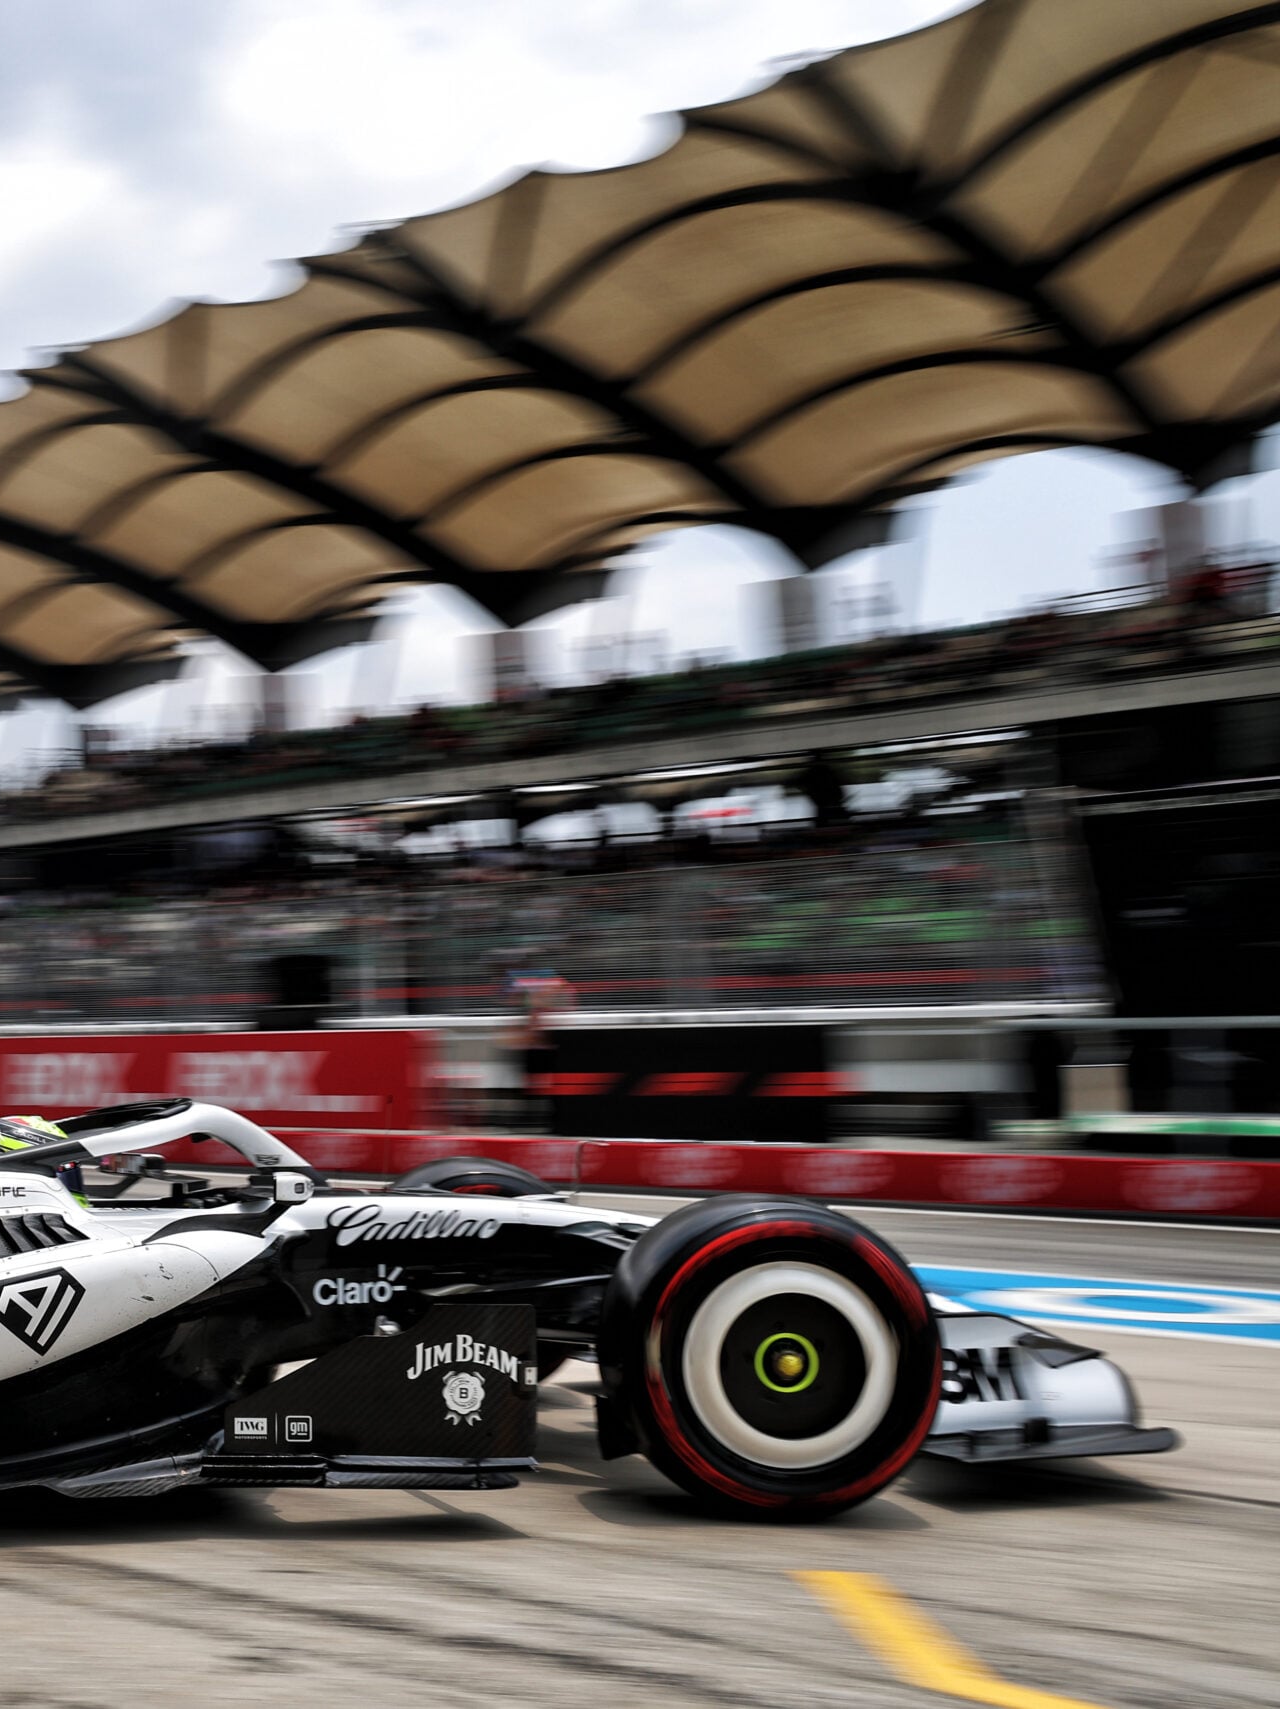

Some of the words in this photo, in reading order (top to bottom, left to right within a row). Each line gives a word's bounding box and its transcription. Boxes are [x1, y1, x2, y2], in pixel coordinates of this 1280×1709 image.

[326, 1203, 501, 1247] Cadillac
[312, 1277, 394, 1305] Claro
[406, 1342, 453, 1380] JIM
[455, 1333, 519, 1383] BEAM
[459, 1387, 469, 1399] B
[237, 1420, 265, 1432] TWG
[289, 1421, 308, 1436] gm
